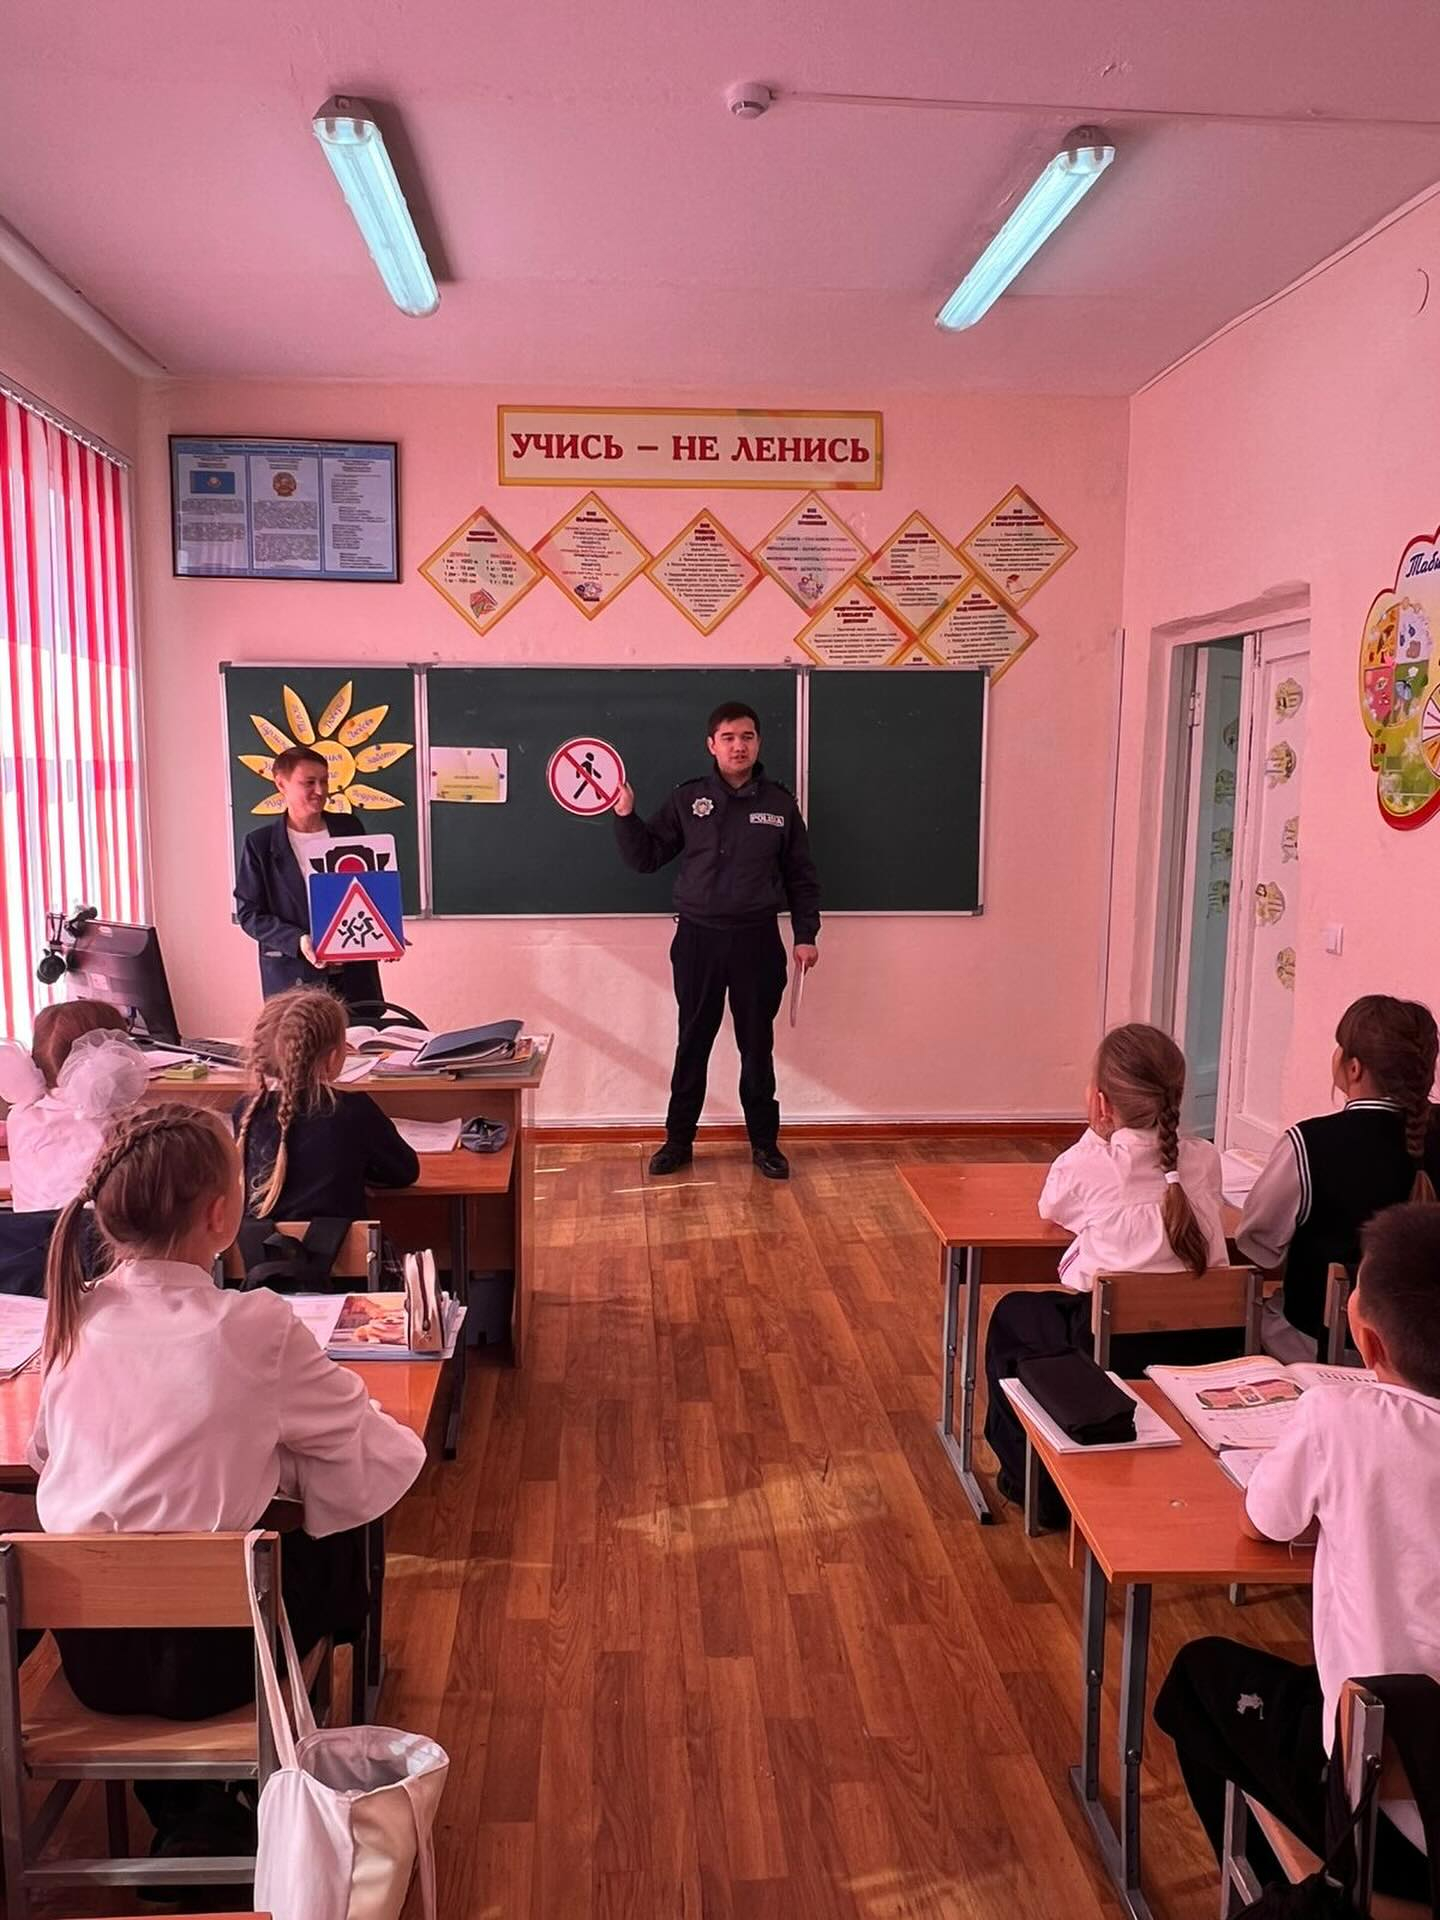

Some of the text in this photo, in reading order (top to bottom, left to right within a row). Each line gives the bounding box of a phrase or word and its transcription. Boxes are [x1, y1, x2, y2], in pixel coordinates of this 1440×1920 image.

[510, 433, 624, 460] УЧИСЬ
[672, 435, 720, 461] НЕ
[731, 436, 870, 463] ЛЕНИСЬ
